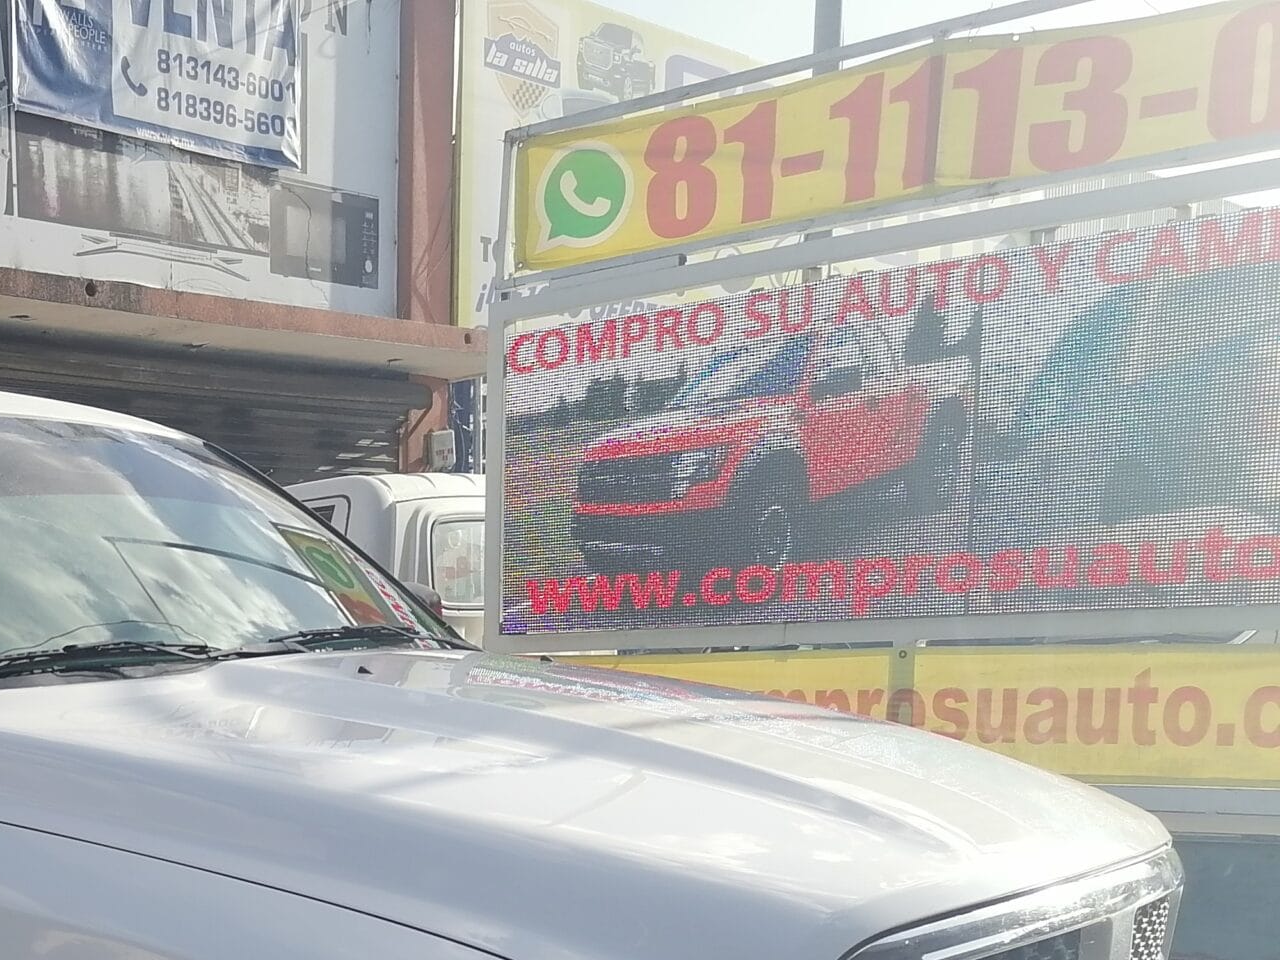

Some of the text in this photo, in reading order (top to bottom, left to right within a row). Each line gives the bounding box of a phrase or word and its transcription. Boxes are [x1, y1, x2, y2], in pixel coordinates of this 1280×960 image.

[68, 22, 107, 46] PEOPLE
[486, 42, 560, 83] la silla
[509, 42, 537, 57] autos
[643, 3, 1280, 239] 81-1113-0
[506, 302, 724, 374] COMPRO
[743, 284, 815, 339] SU
[834, 255, 1013, 326] AUTO
[1030, 243, 1075, 295] Y
[525, 525, 1280, 617] www.comprosuauto
[756, 667, 1280, 749] rosuauto.c
